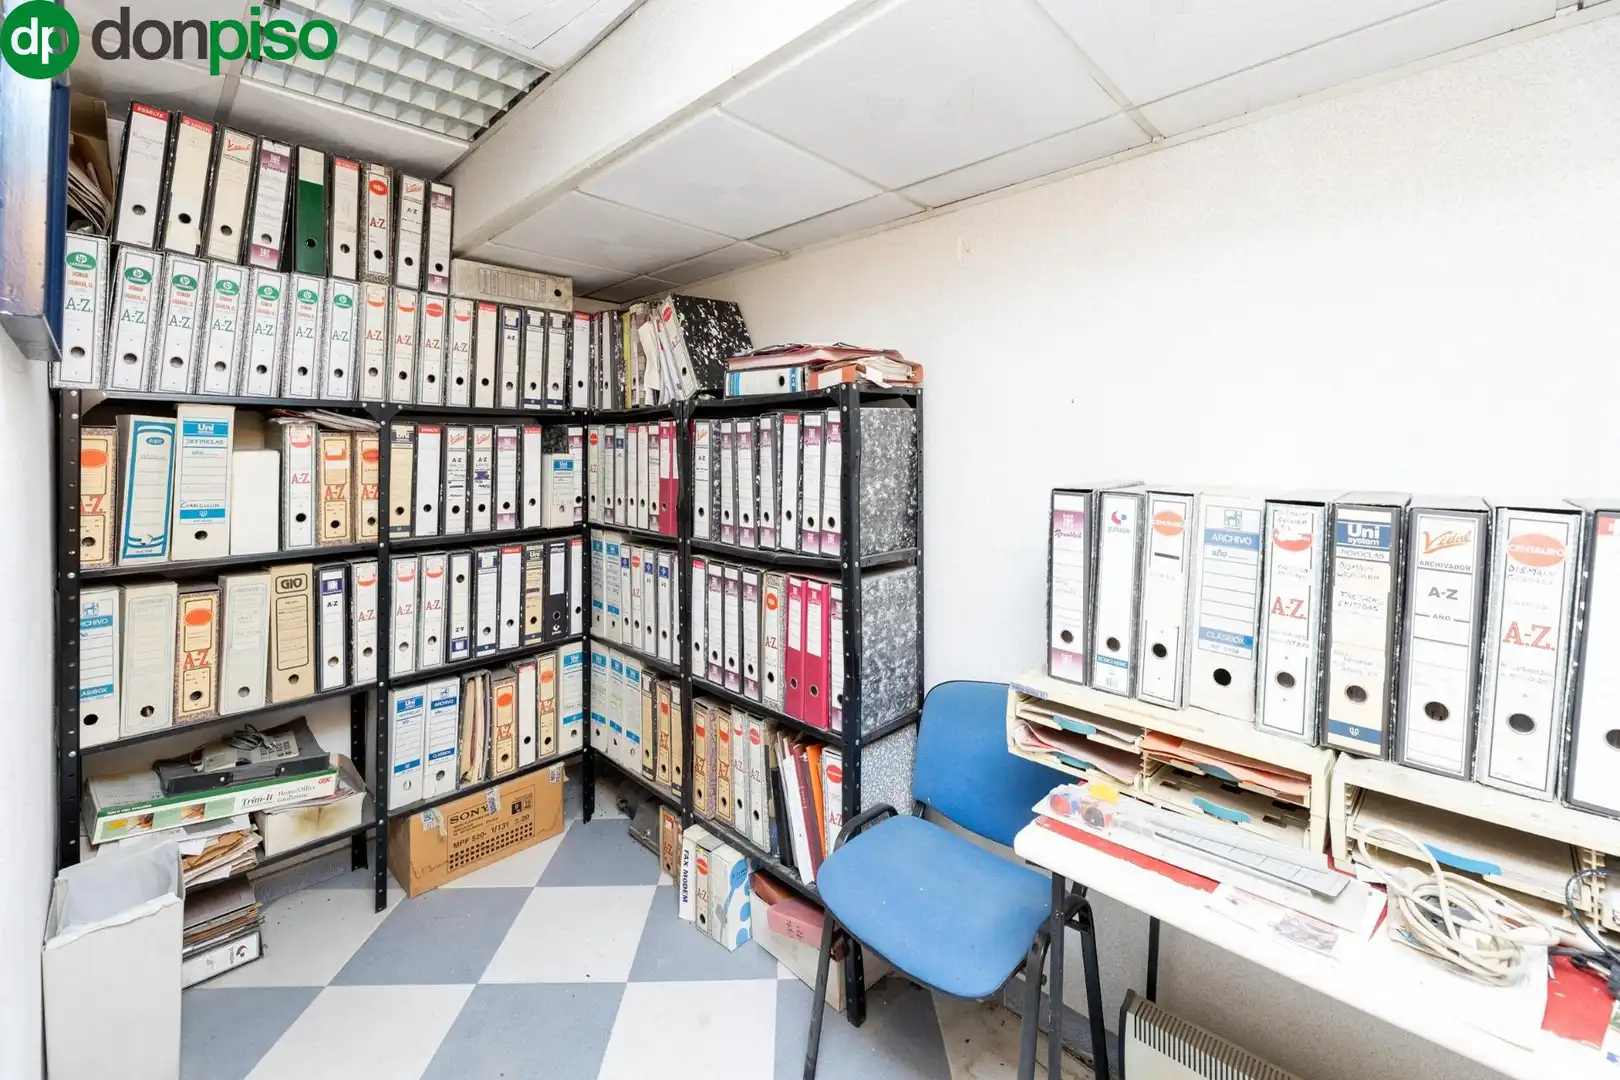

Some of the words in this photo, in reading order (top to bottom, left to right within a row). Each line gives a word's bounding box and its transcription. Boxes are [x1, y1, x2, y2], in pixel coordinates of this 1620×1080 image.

[1347, 522, 1380, 539] Uni
[1211, 534, 1253, 545] ARCHIVO
[1347, 537, 1380, 546] system
[1421, 530, 1472, 554] Vidal
[1340, 548, 1385, 559] NOVOCLAS
[1508, 544, 1566, 557] CENTAURO
[1419, 560, 1472, 572] ARCHIVADOR
[280, 577, 303, 589] GIO
[1427, 586, 1459, 601] A-Z
[241, 793, 274, 806] Trim-It
[449, 804, 489, 825] SONY
[452, 837, 470, 849] MPF
[681, 868, 689, 903] MODEM
